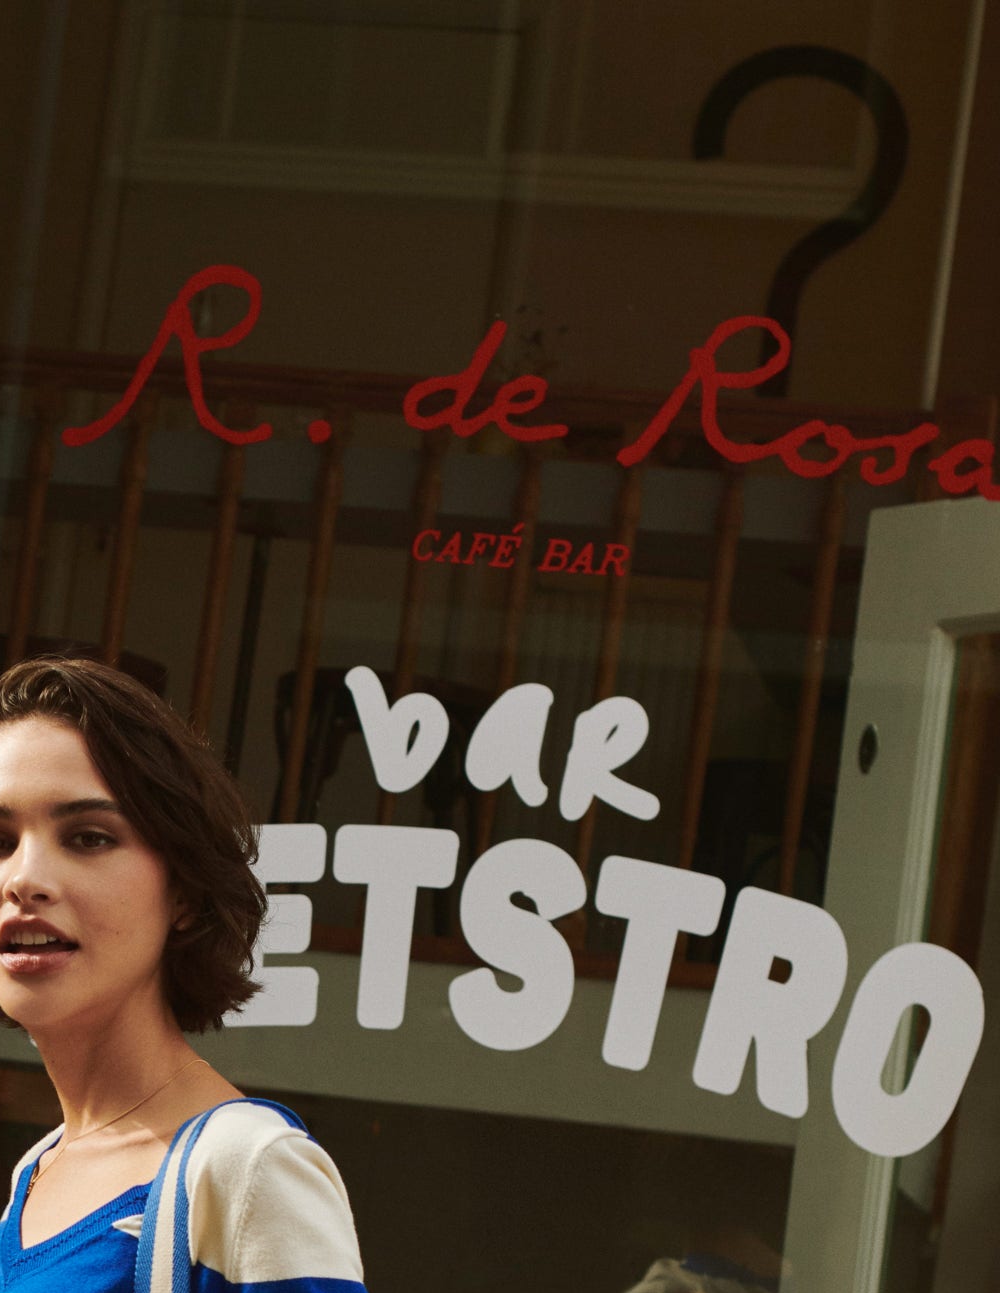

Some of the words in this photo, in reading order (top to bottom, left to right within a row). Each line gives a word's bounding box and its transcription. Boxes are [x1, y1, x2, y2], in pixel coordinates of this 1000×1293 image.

[403, 320, 568, 442] de
[617, 315, 1000, 501] Rosa
[411, 521, 525, 568] CAFÉ
[537, 538, 631, 577] BAR
[221, 823, 985, 1157] ETSTRO
